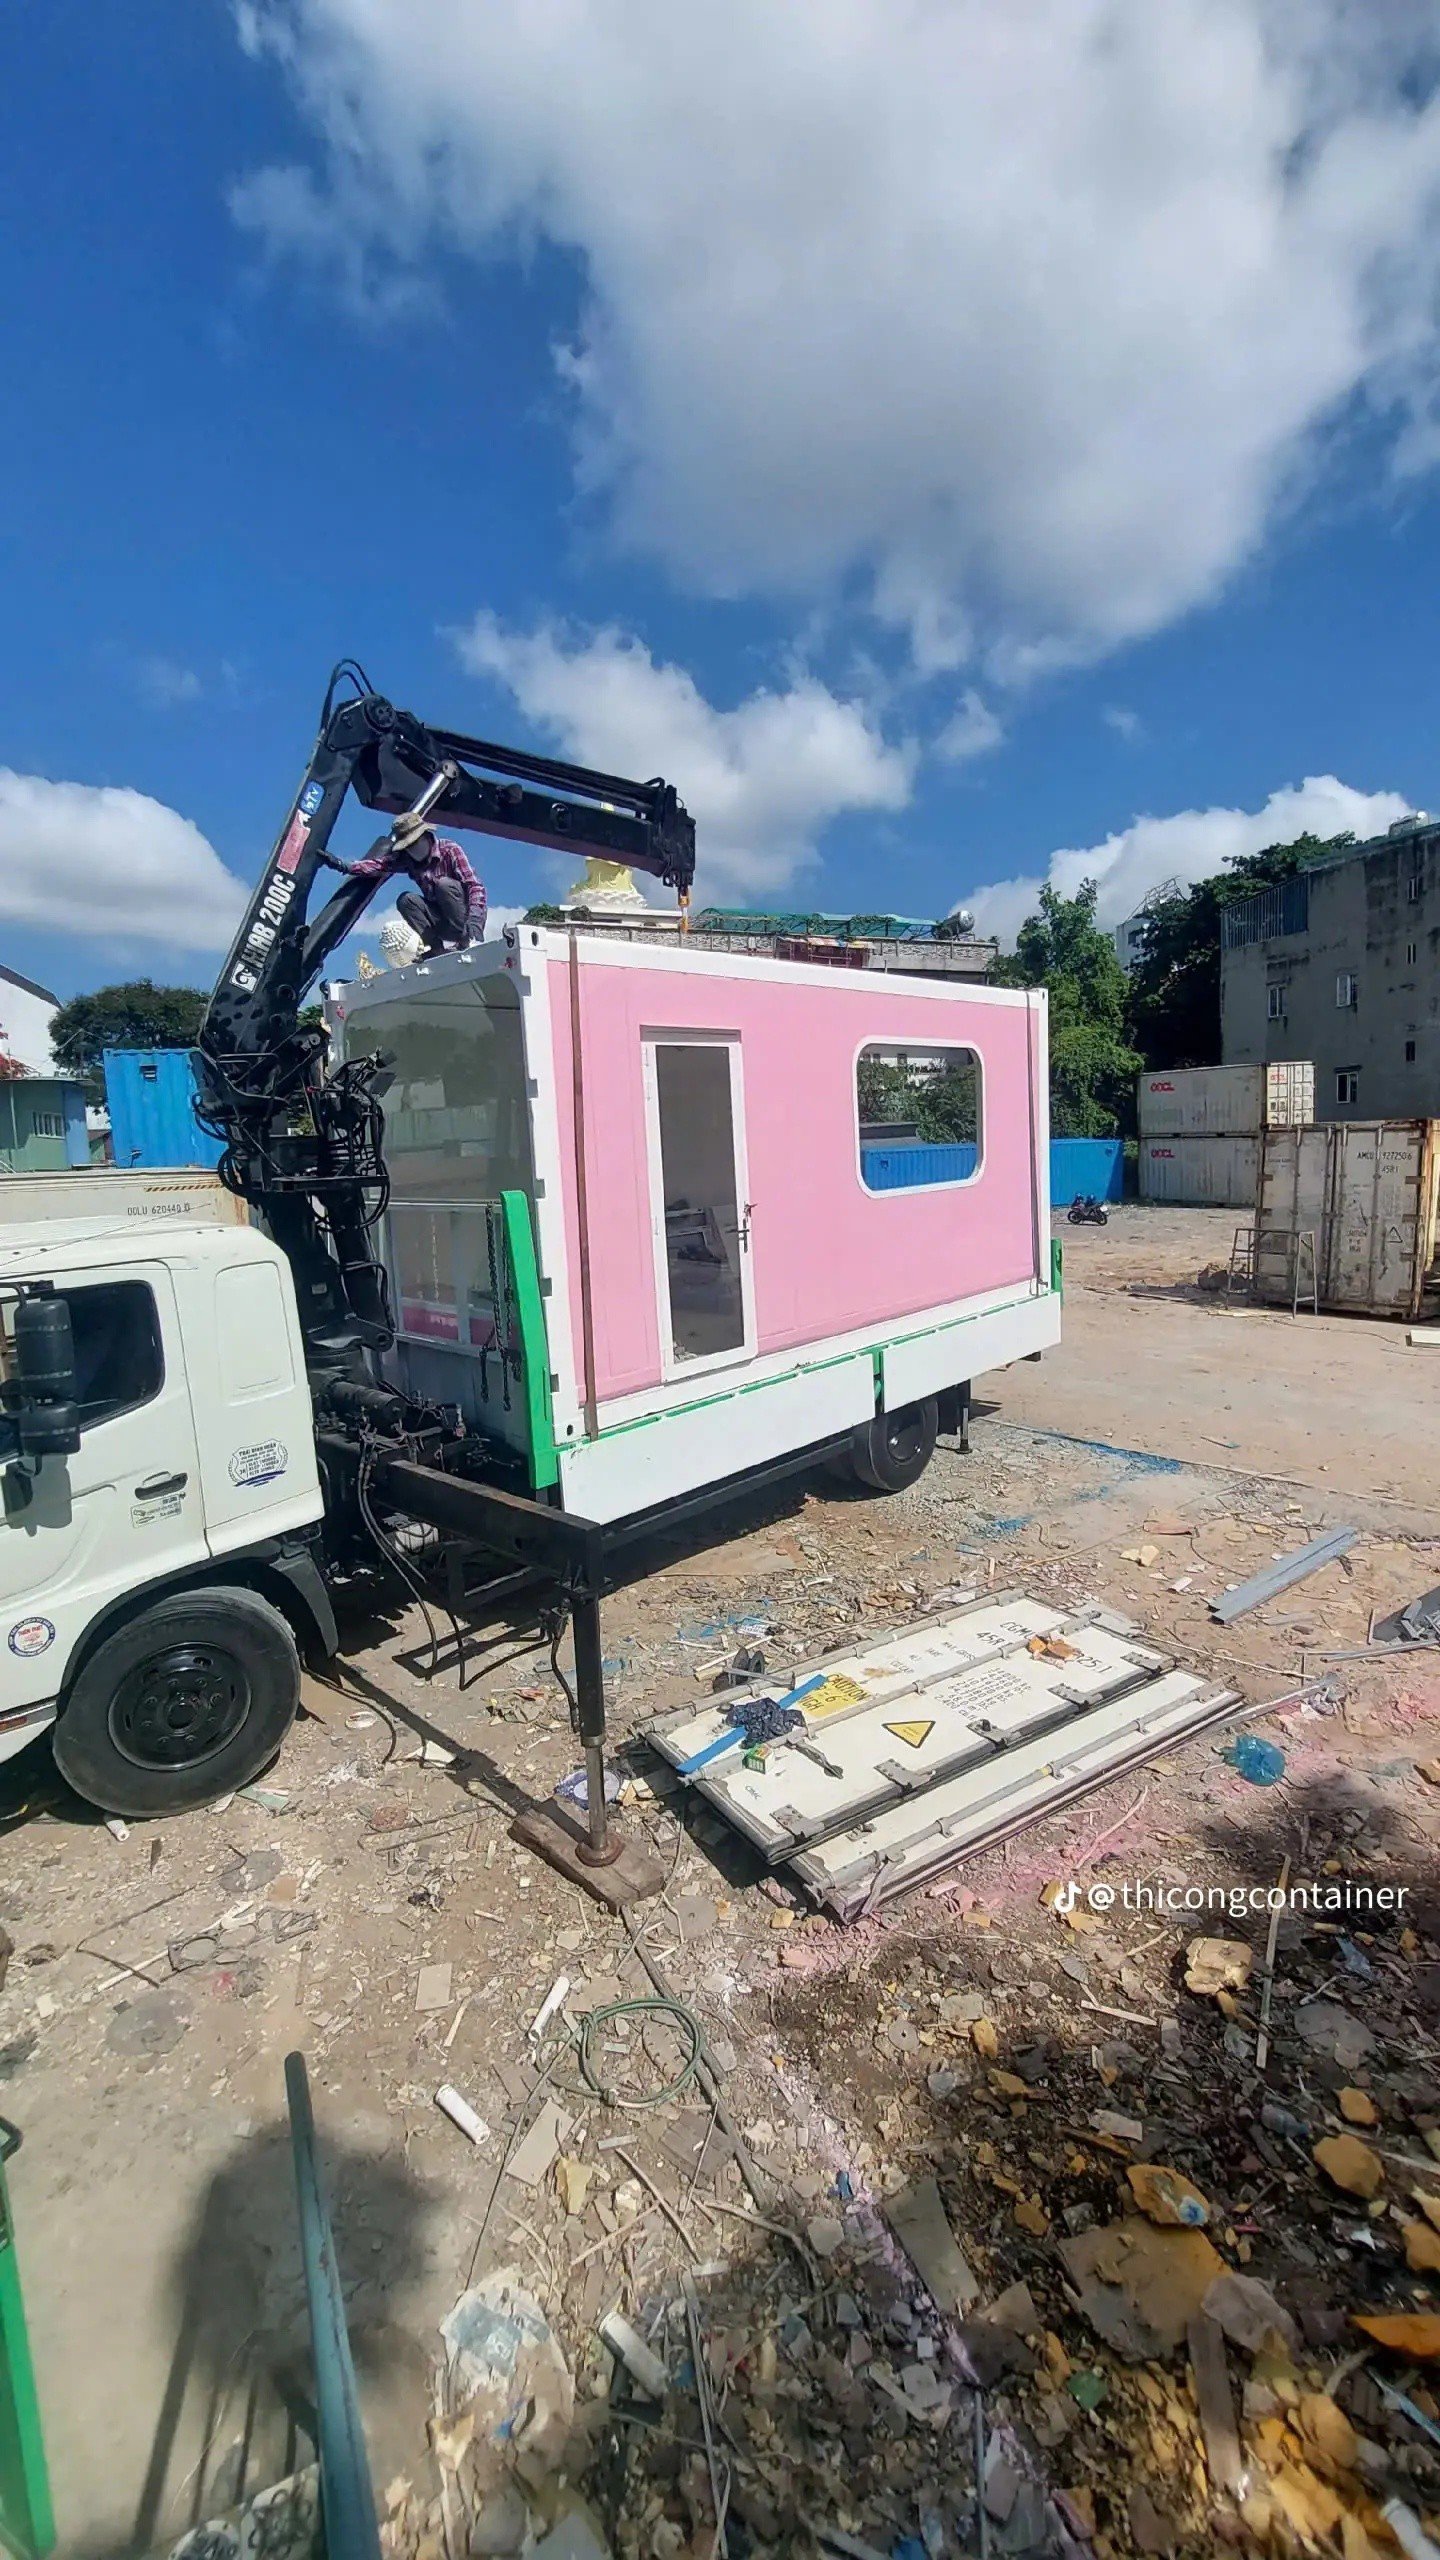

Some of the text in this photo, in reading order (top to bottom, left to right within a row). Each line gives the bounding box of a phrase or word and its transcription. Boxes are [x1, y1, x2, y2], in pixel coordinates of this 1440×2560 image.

[241, 873, 296, 969] HIAB 200C
[1150, 1082, 1175, 1092] OOCL
[127, 1205, 148, 1215] OOLU
[826, 1674, 872, 1702] CAUTION
